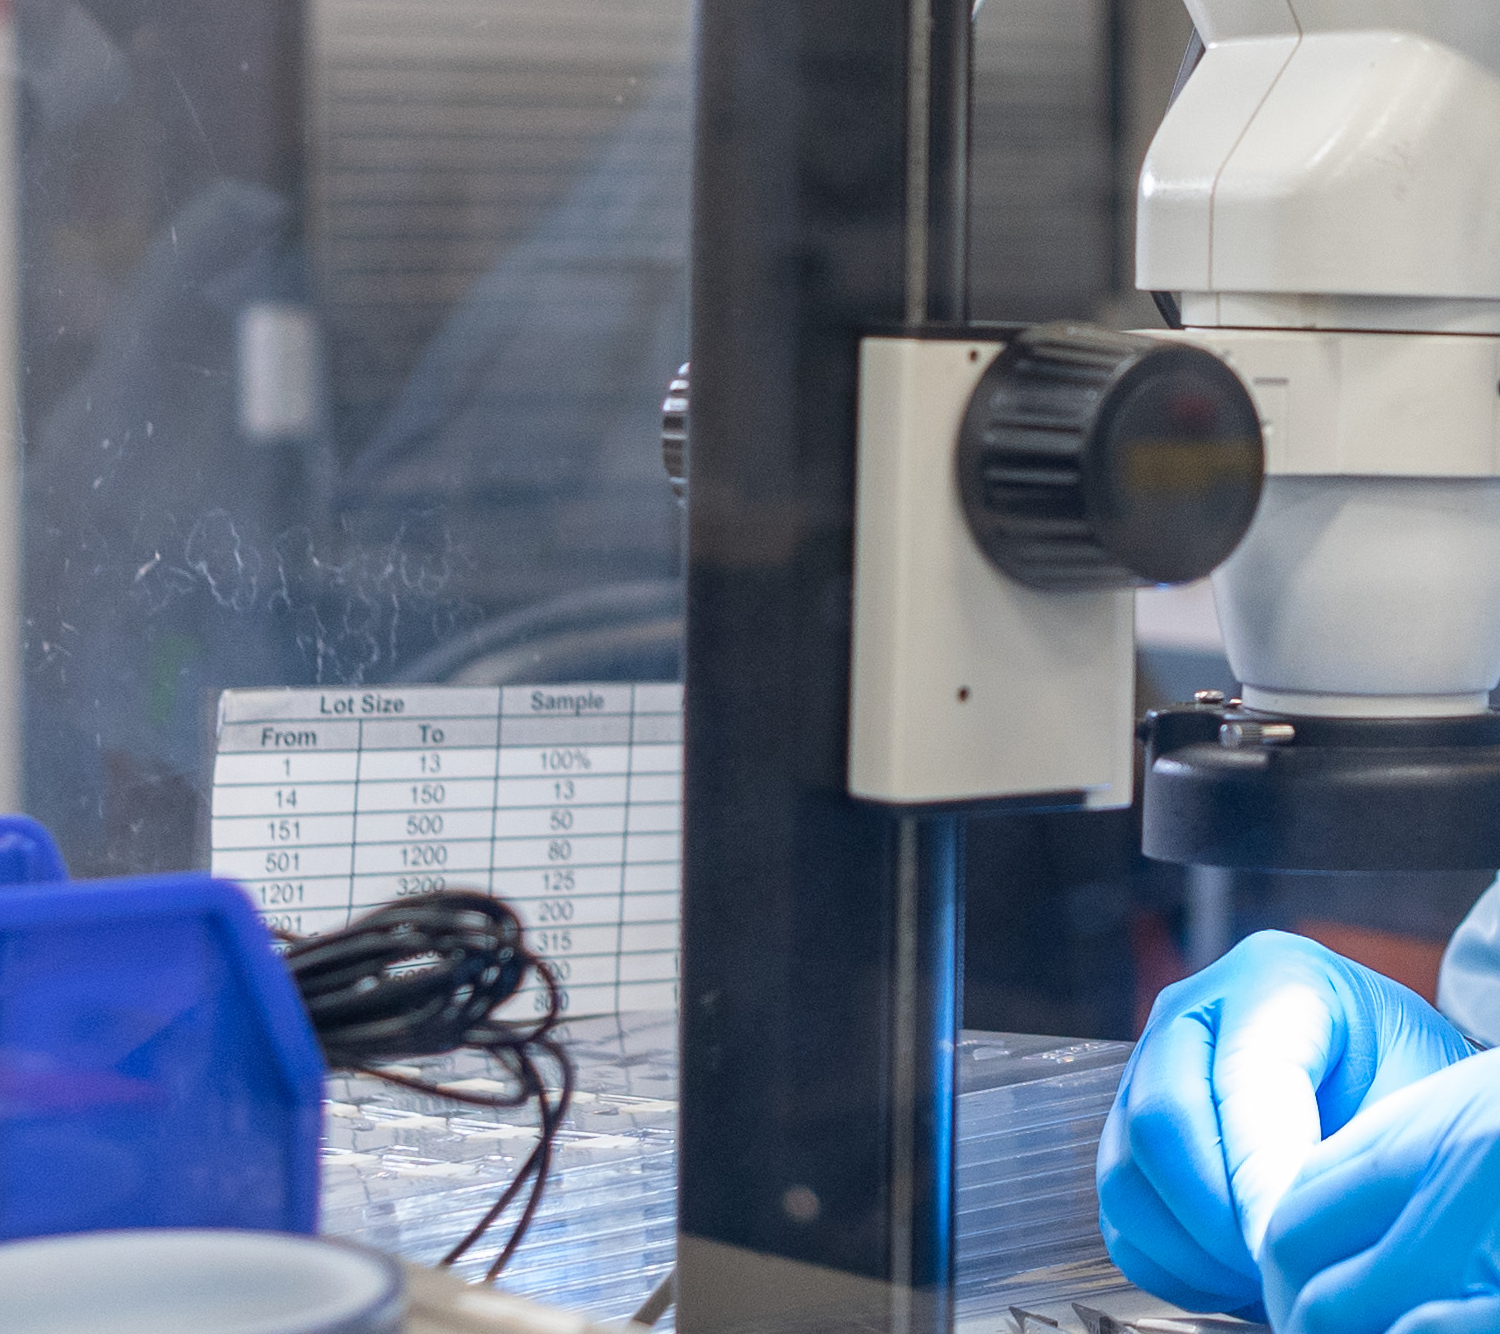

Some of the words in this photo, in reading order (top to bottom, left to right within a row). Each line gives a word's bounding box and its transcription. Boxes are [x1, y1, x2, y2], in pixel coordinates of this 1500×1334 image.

[319, 695, 355, 715] Lot
[361, 693, 405, 714] Size
[530, 690, 605, 717] Sample
[260, 727, 317, 747] From
[418, 724, 445, 744] To
[282, 757, 291, 777] 1
[420, 752, 442, 774] 13
[538, 749, 592, 771] 100%
[275, 789, 298, 809] 14
[411, 784, 446, 805] 150
[553, 779, 576, 801] 13
[268, 820, 300, 841] 151
[406, 814, 444, 836] 500
[550, 810, 574, 831] 50
[401, 845, 448, 866] 1200
[548, 840, 572, 861] 80
[266, 852, 301, 873] 501
[397, 876, 446, 897] 3200
[542, 870, 576, 892] 125
[260, 883, 304, 905] 1201
[539, 901, 574, 922] 200
[536, 931, 572, 952] 315
